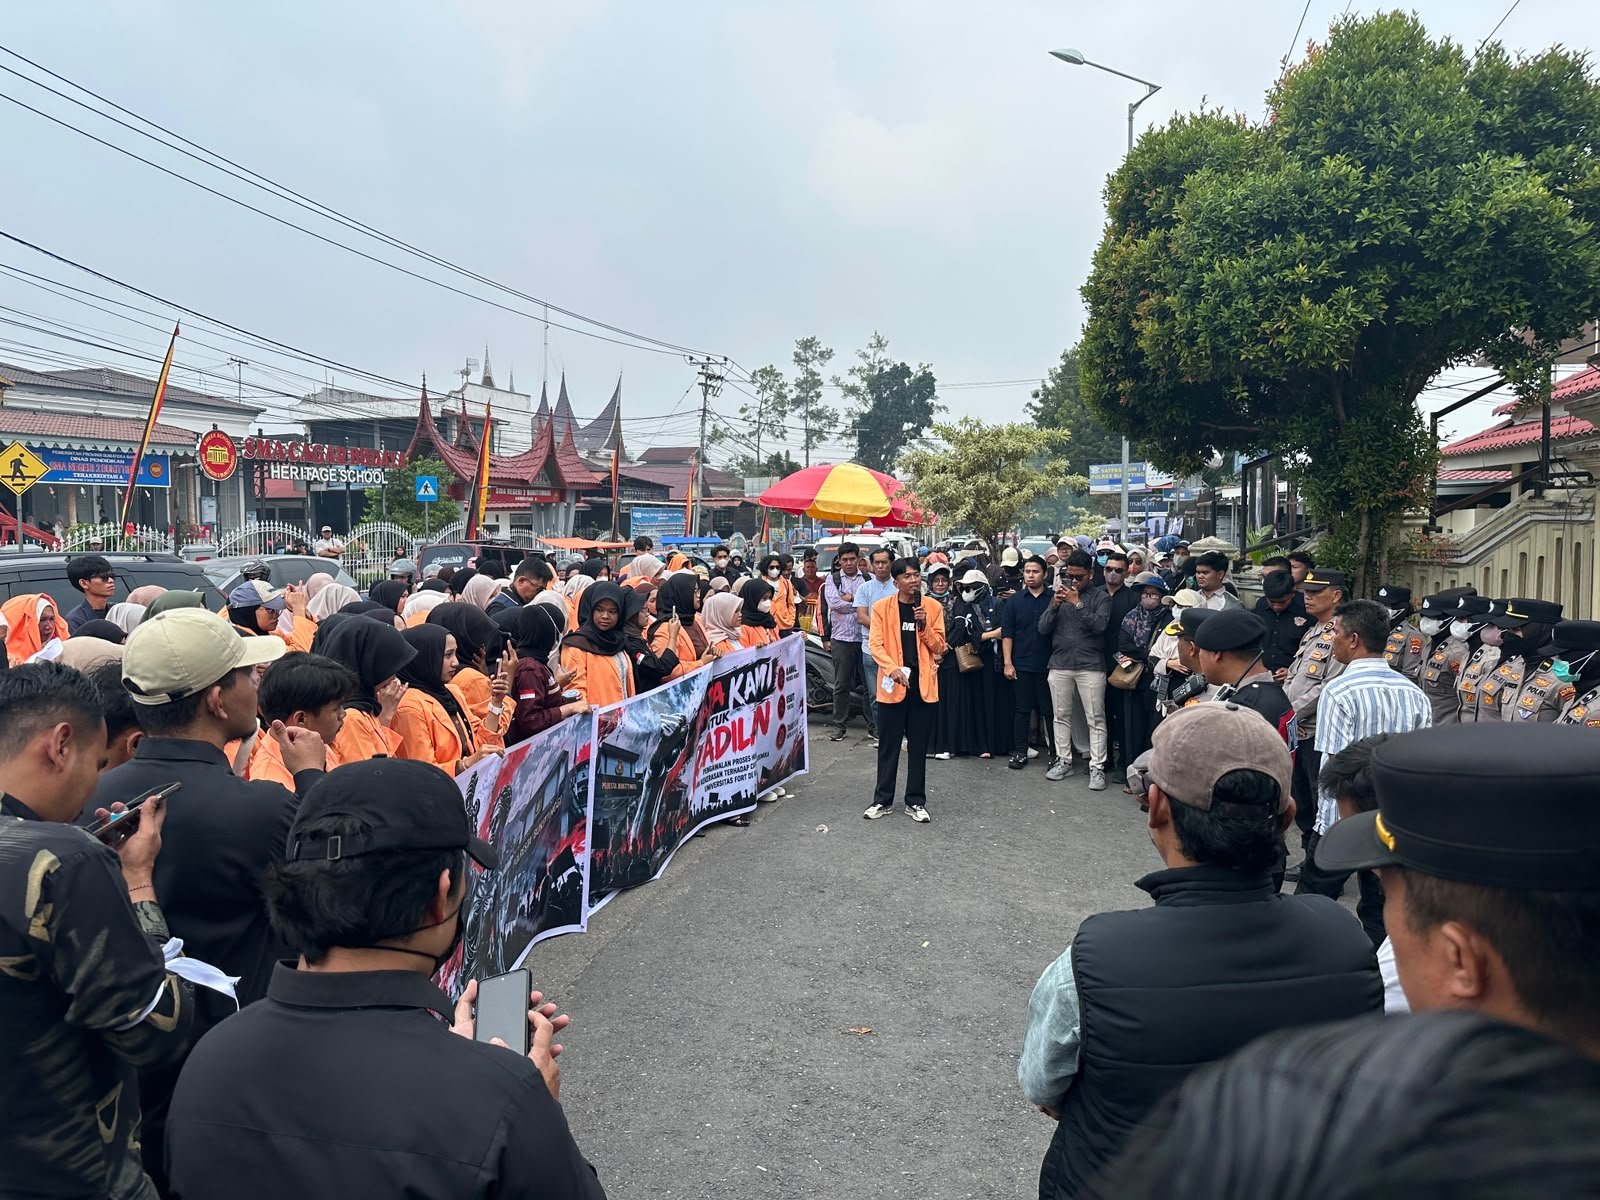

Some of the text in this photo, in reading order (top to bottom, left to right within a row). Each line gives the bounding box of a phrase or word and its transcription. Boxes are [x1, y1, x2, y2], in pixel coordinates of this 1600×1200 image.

[243, 437, 286, 460] SMA
[287, 440, 347, 464] CAGAR
[270, 464, 389, 485] HERITAGE SCHOOL
[1315, 642, 1331, 650] POLRI
[728, 660, 773, 713] KAMI
[1526, 685, 1547, 698] POLRI
[706, 711, 730, 731] TUK
[703, 760, 732, 775] PENGAWALAN
[732, 755, 752, 766] PROSES
[724, 766, 750, 776] TERHADAP
[704, 777, 734, 792] UNIVERSITAS
[734, 772, 747, 783] FORT
